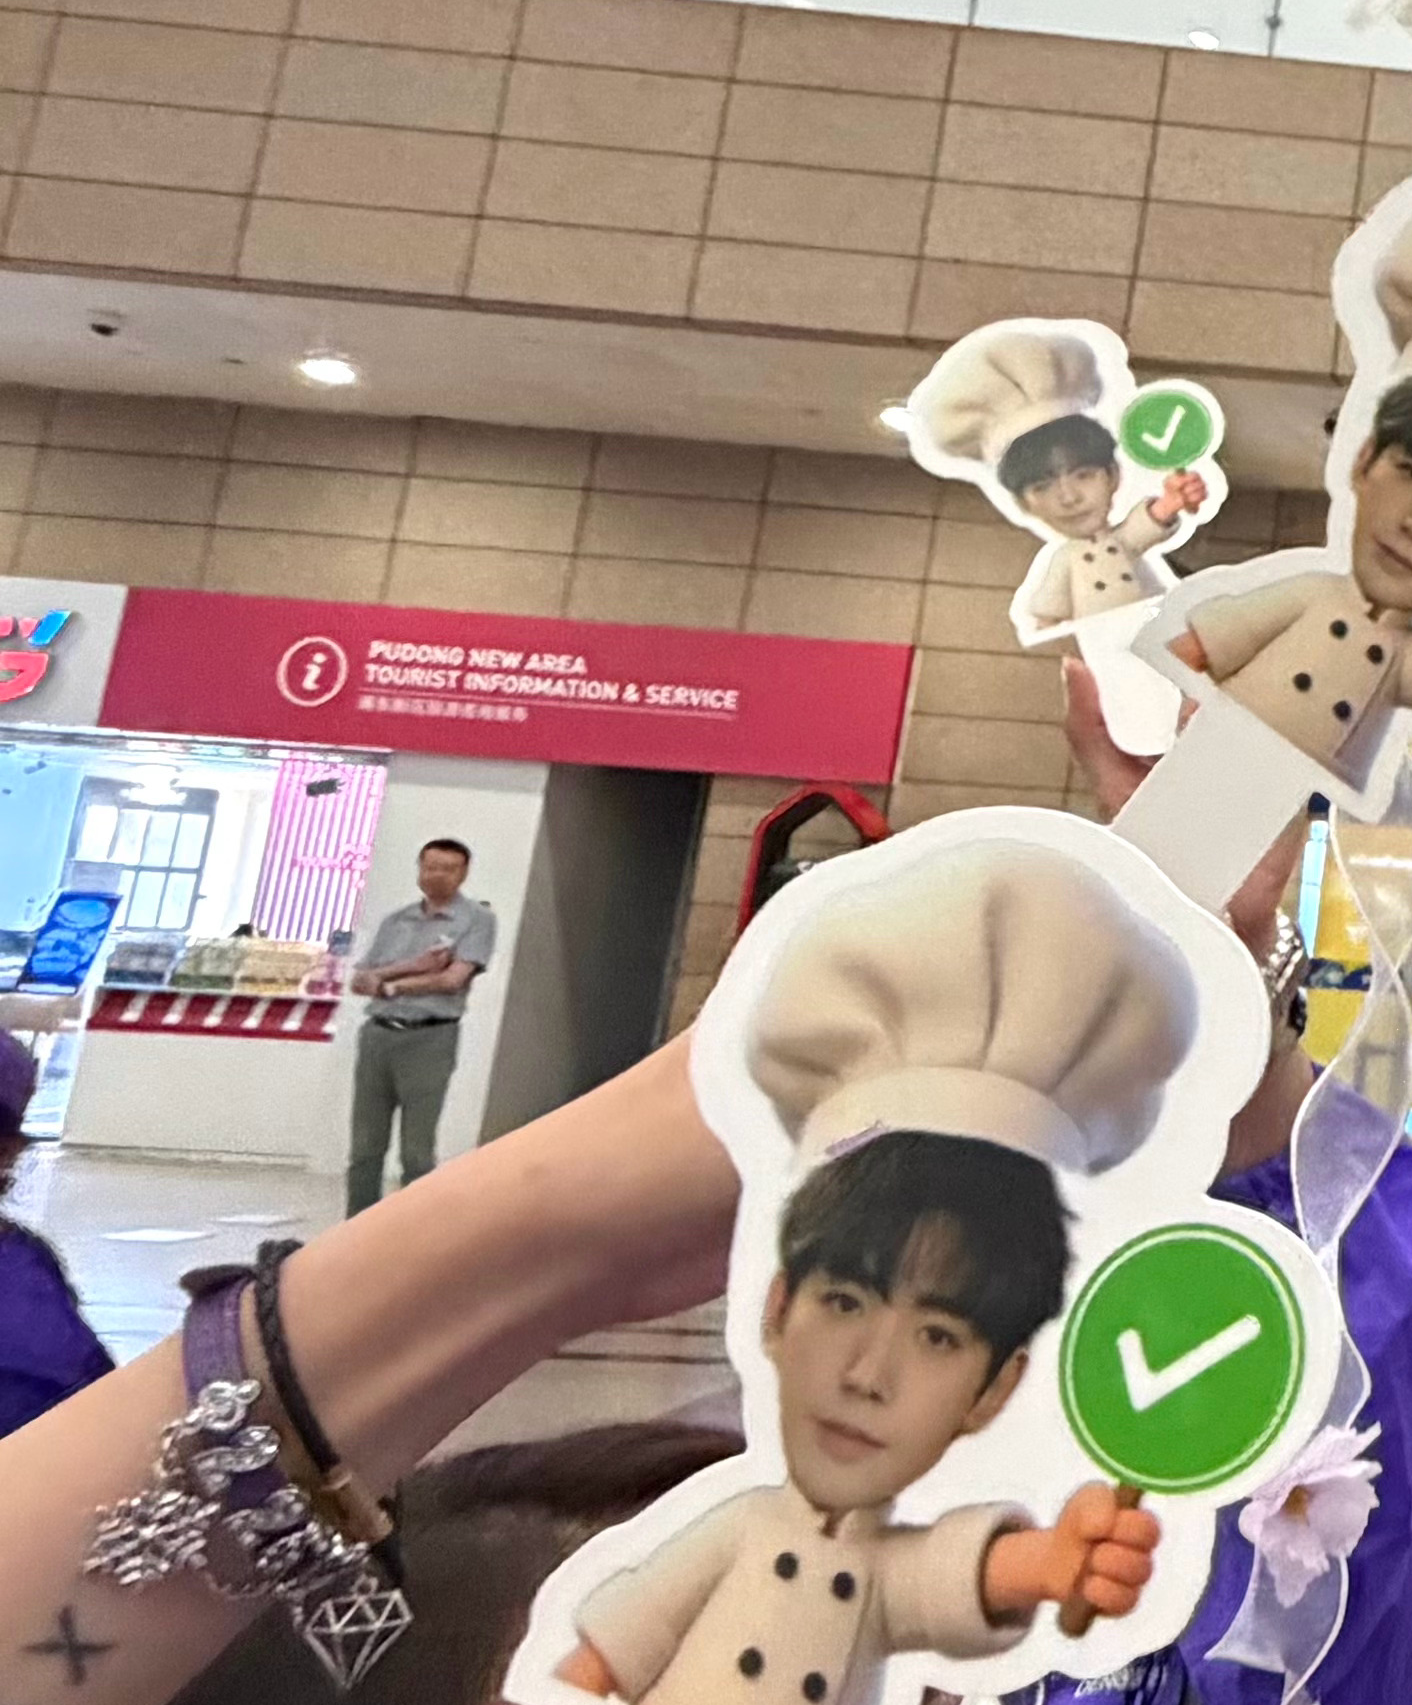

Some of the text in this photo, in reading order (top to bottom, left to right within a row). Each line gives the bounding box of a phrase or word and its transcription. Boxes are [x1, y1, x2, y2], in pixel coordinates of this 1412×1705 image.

[369, 640, 588, 675] PUDONG NEW AREA
[365, 663, 739, 710] TOURIST INFORMATION & SERVICE
